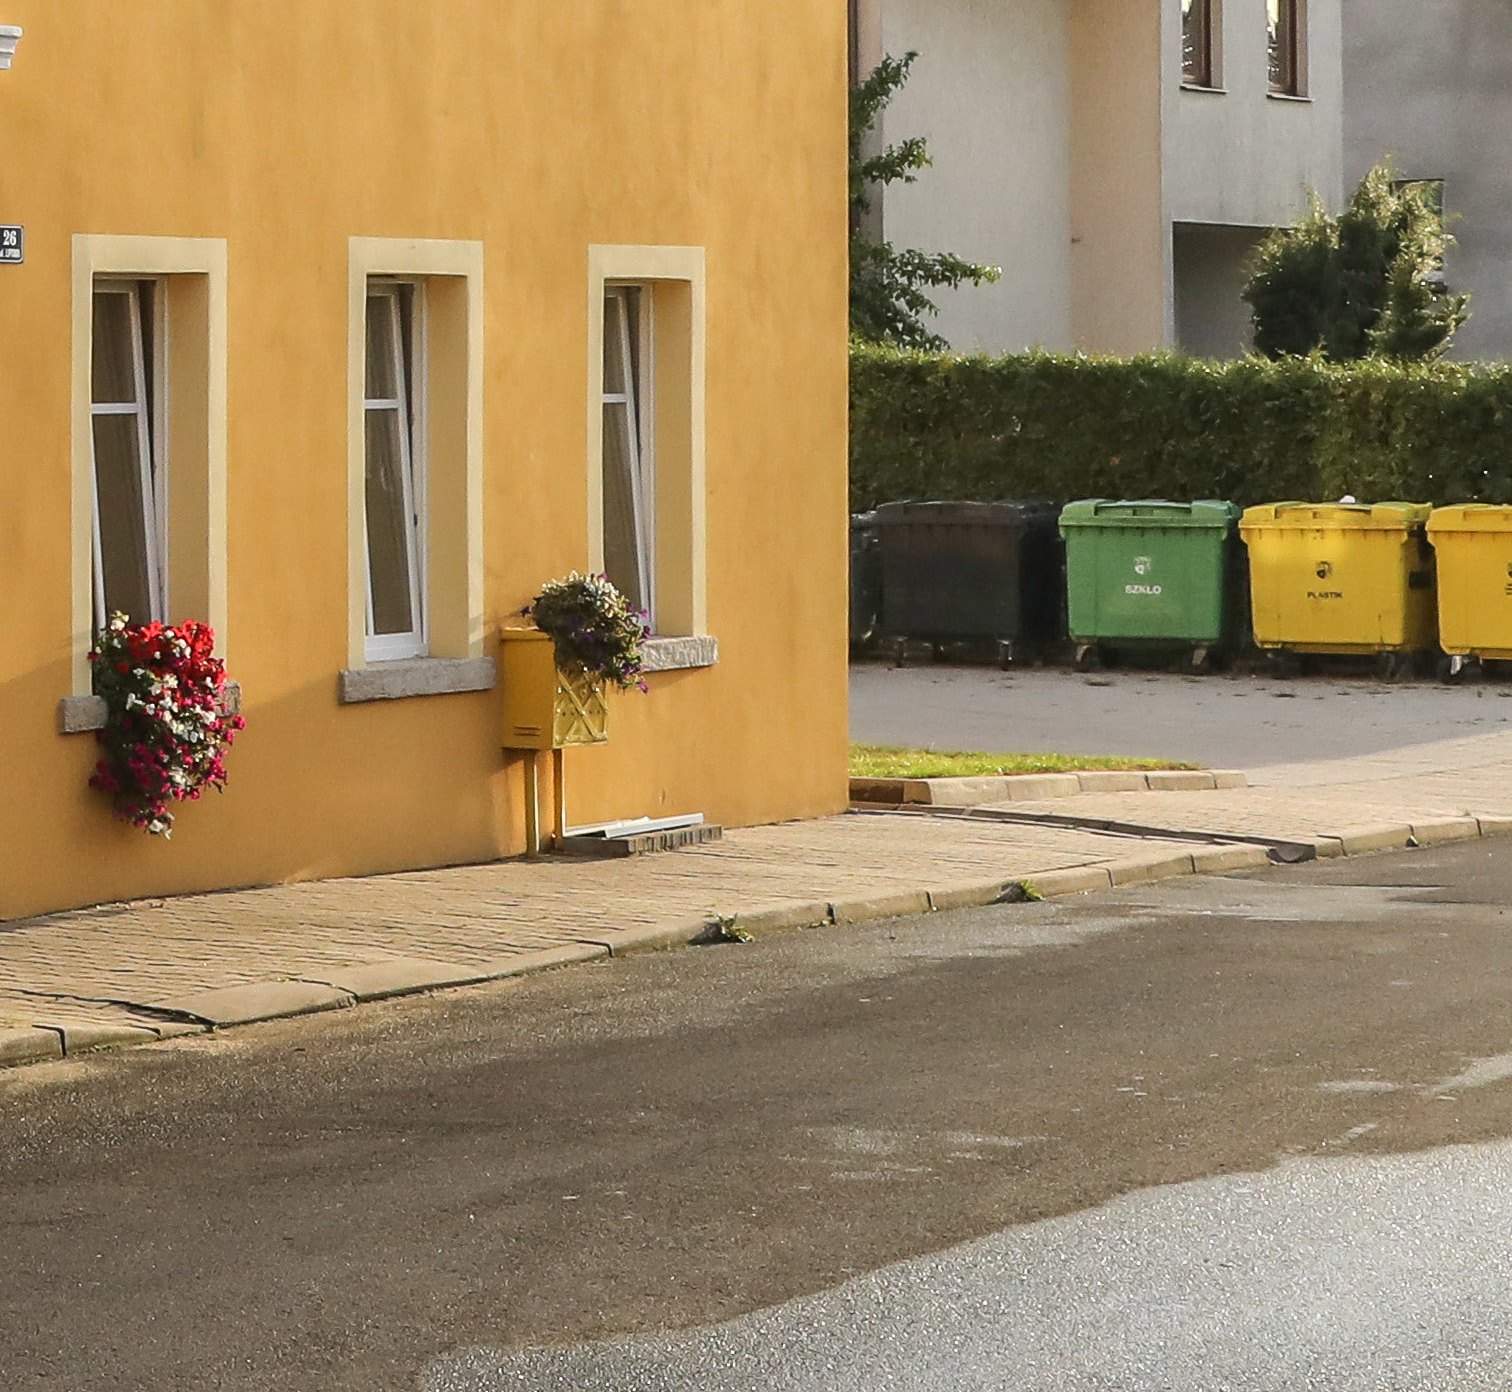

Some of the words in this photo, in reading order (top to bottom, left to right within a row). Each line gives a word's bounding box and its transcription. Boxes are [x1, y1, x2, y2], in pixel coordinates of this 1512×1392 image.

[2, 229, 17, 246] 26
[1124, 584, 1162, 595] SZKŁO
[1306, 590, 1344, 599] PLASTIK
